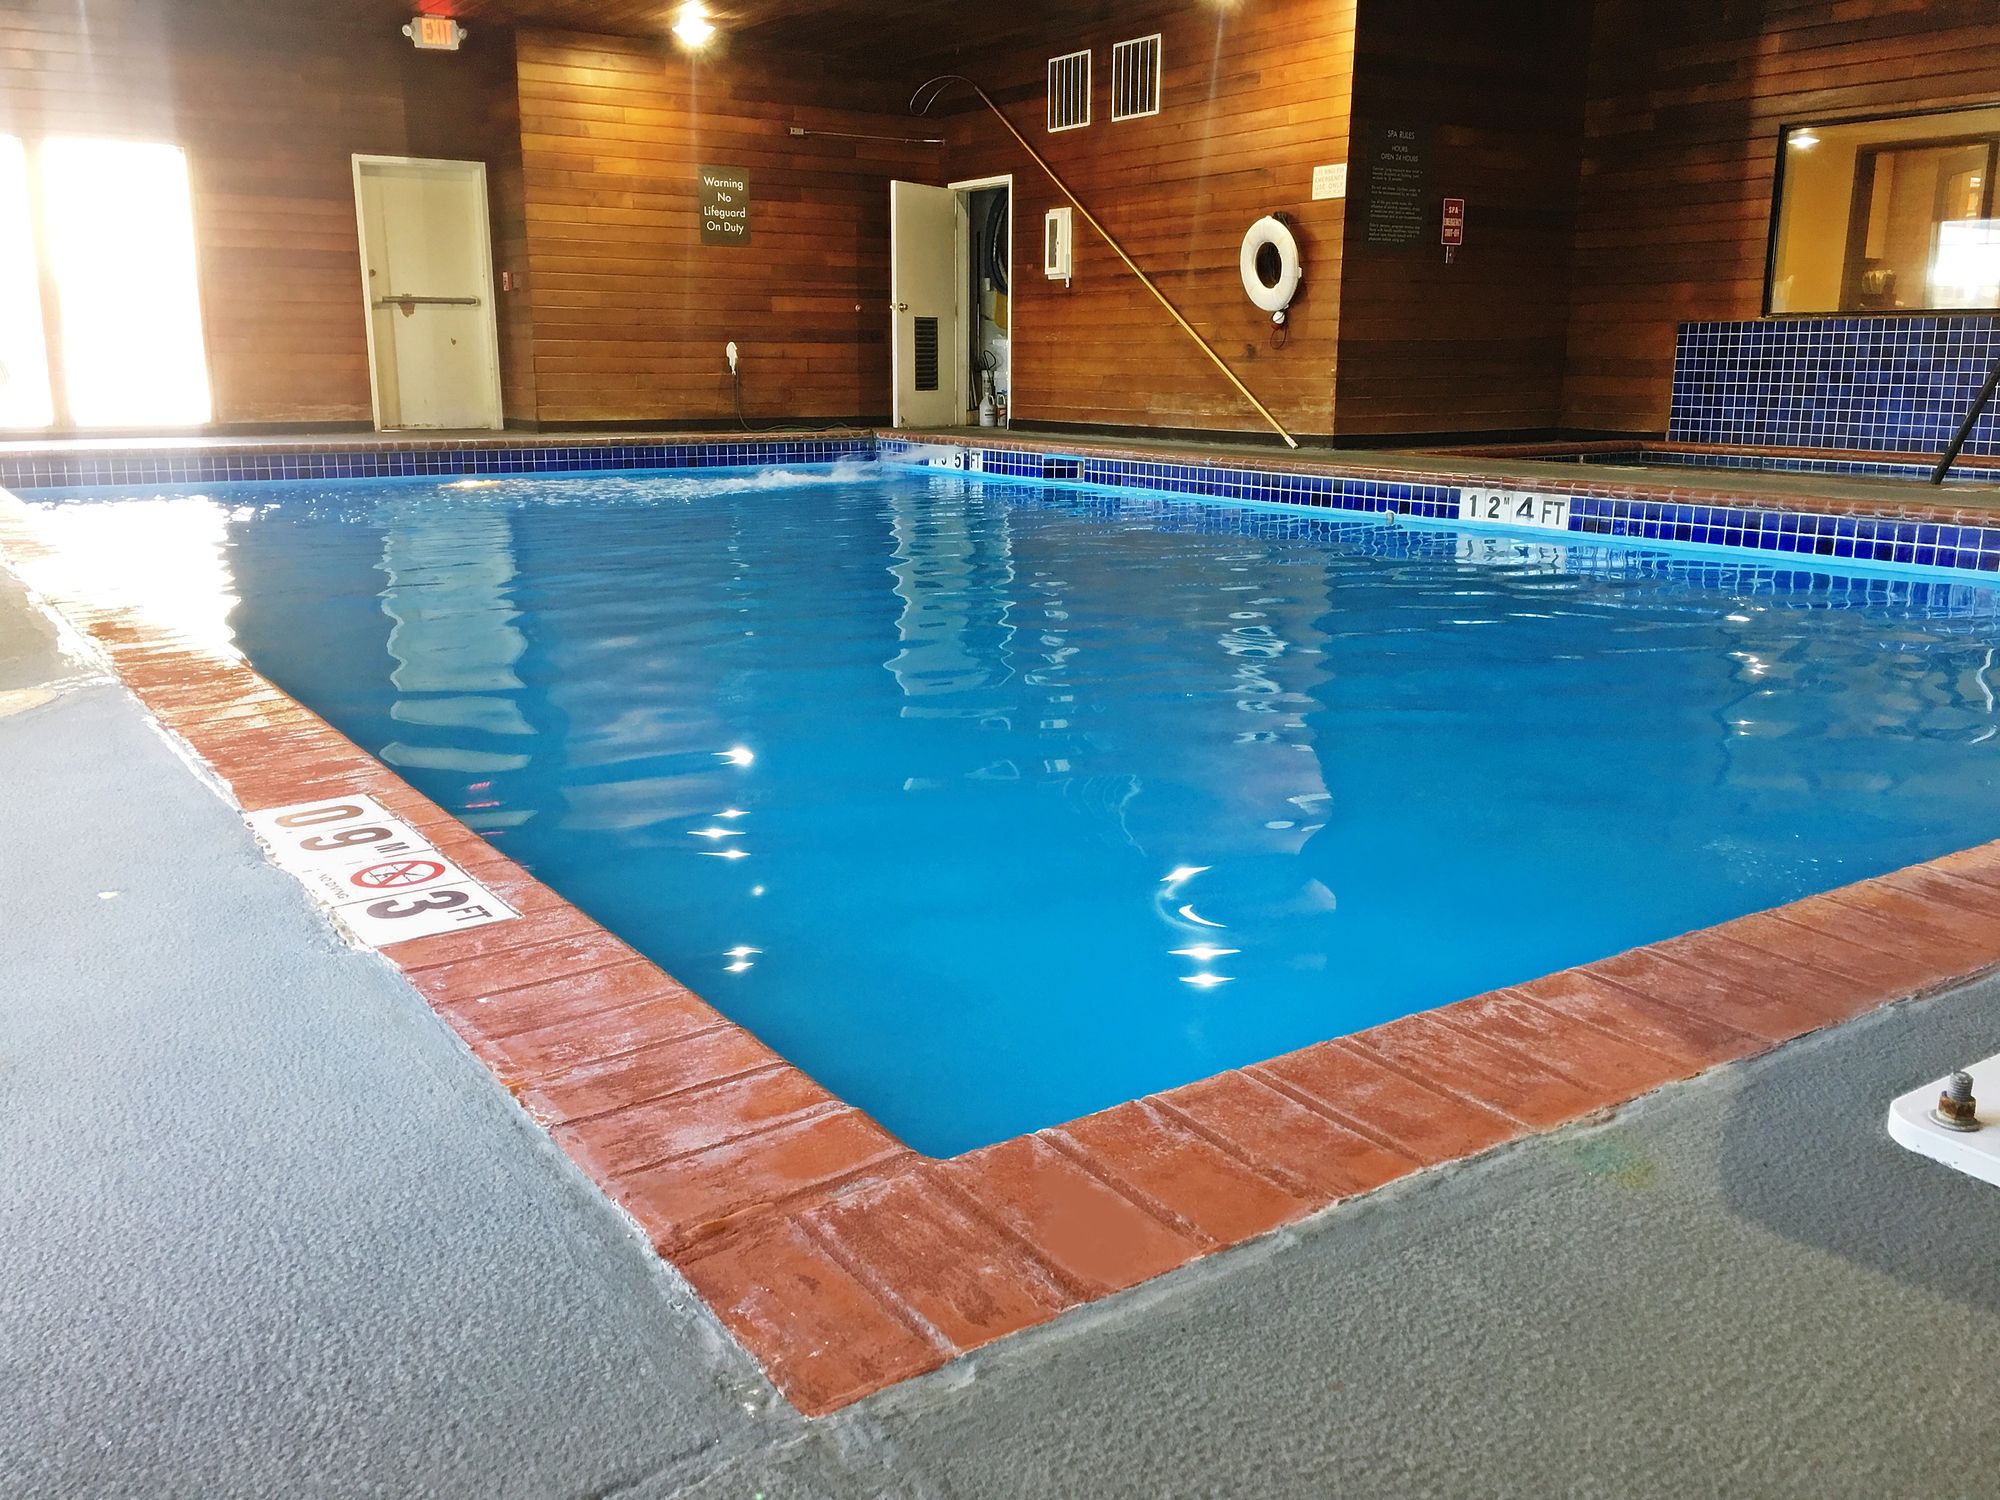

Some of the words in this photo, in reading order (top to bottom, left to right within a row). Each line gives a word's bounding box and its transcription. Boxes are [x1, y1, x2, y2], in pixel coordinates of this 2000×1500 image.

[421, 18, 453, 45] EXIT
[703, 176, 743, 191] Warning
[717, 192, 732, 202] No
[703, 205, 746, 219] Lifeguard
[706, 220, 721, 231] On
[723, 222, 744, 235] Duty
[954, 453, 962, 468] 5
[970, 453, 981, 468] FT
[1541, 500, 1565, 525] FT
